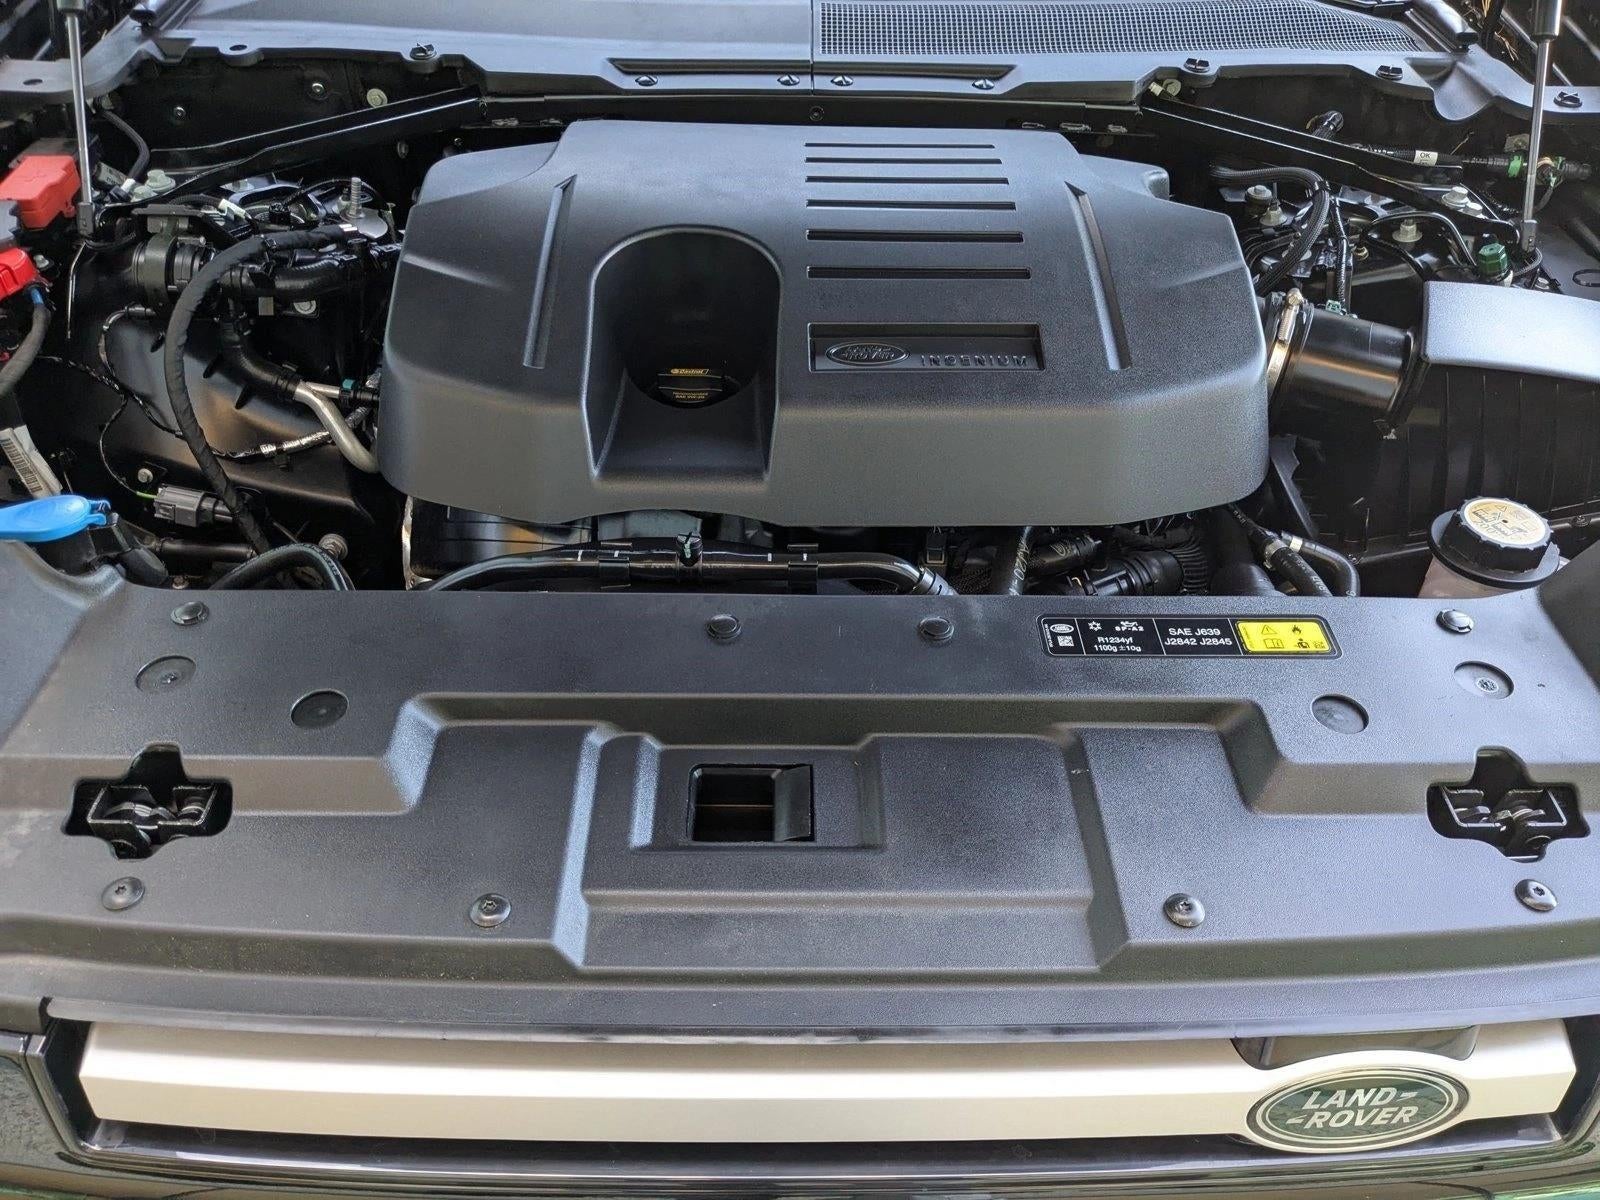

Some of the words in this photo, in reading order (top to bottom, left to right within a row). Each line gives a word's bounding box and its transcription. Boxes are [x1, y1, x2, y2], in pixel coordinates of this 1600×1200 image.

[921, 355, 1028, 367] INGENIUM
[1168, 628, 1193, 636] SAE
[1195, 628, 1221, 636] J639
[1097, 636, 1133, 644] R1234yf
[1164, 638, 1197, 646] J2842
[1199, 638, 1233, 646] J2845
[1301, 1087, 1398, 1110] LAND
[1304, 1106, 1419, 1129] ROVER
